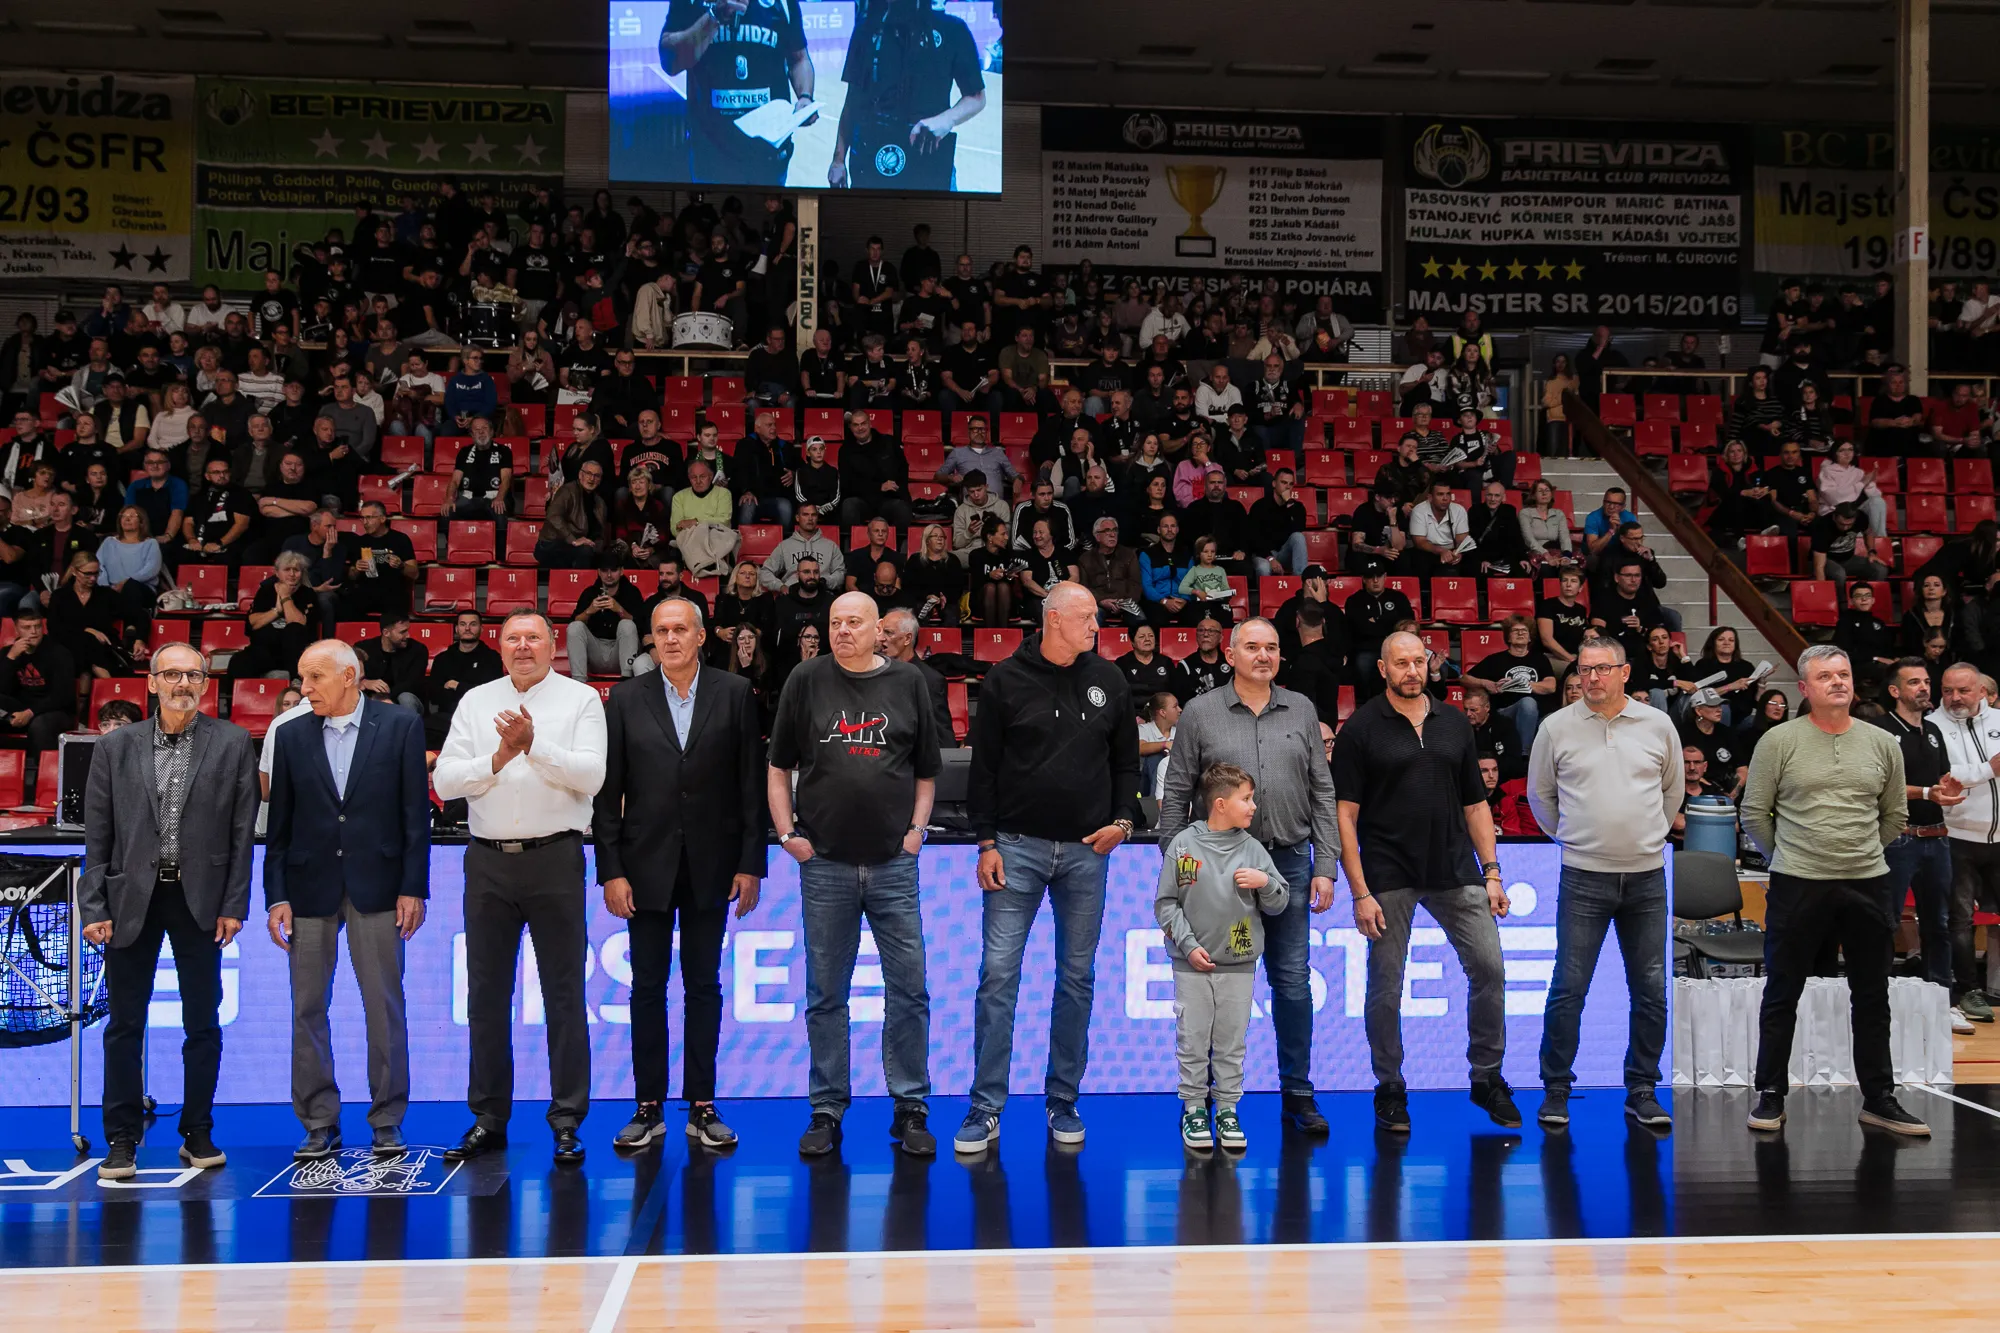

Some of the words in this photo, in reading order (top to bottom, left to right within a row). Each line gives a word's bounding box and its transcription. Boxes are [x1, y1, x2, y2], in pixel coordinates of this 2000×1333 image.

[0, 75, 173, 121] evidza
[716, 93, 769, 103] PARTNERS
[269, 93, 326, 116] BC
[332, 95, 554, 125] PRIEVIDZA
[1174, 123, 1302, 139] PRIEVIDZA
[27, 121, 168, 172] ČSFR
[1781, 130, 1848, 167] BC
[1503, 140, 1727, 168] PRIEVIDZA
[1067, 161, 1102, 171] Maxim
[1249, 167, 1268, 176] #17
[1270, 167, 1293, 178] Filip
[1500, 169, 1600, 183] BASKETBALL
[1604, 171, 1644, 183] CLUB
[1648, 172, 1731, 186] PRIEVIDZA
[1052, 175, 1065, 184] #4
[1068, 175, 1099, 184] Jakub
[1102, 175, 1150, 187] Pasovský
[1271, 180, 1301, 190] Jakub
[1052, 187, 1065, 196] #5
[1068, 188, 1097, 198] Matej
[1248, 193, 1267, 201] #21
[1307, 194, 1350, 203] Johnson
[1410, 192, 1491, 208] PASOVSKÝ
[1500, 195, 1607, 208] ROSTAMPOUR
[1674, 198, 1729, 210] BATINA
[1053, 200, 1072, 209] #10
[1075, 200, 1108, 210] Nenad
[1248, 206, 1267, 215] #23
[1270, 206, 1309, 216] Ibrahim
[1312, 207, 1345, 216] Durmo
[1053, 213, 1072, 222] #12
[1075, 214, 1114, 223] Andrew
[1117, 214, 1157, 226] Guillory
[1249, 219, 1268, 228] #25
[1271, 219, 1301, 229] Jakub
[1052, 227, 1072, 236] #15
[1075, 227, 1107, 236] Nikola
[1249, 232, 1268, 241] #55
[1271, 232, 1302, 241] Zlatko
[1410, 226, 1472, 240] HULJAK
[1481, 228, 1535, 241] HUPKA
[1612, 227, 1669, 242] KÁDAŠI
[1678, 231, 1738, 243] VOJTEK
[1052, 239, 1072, 248] #16
[1074, 240, 1103, 249] Adam
[1106, 240, 1140, 250] Antoni
[1913, 231, 1924, 255] F
[1224, 246, 1273, 256] Krunoslav
[1655, 252, 1672, 264] M.
[3, 262, 44, 273] Jusko
[1224, 258, 1254, 267] Maroš
[1257, 258, 1299, 269] Helmecy
[1307, 260, 1347, 269] asistent
[1285, 276, 1373, 297] POHÁRA
[1408, 289, 1544, 314] MAJSTER
[1551, 292, 1590, 314] SR
[1598, 292, 1739, 316] 2015/2016
[1348, 421, 1357, 429] 27
[1272, 454, 1281, 462] 25
[1370, 455, 1378, 463] 27
[1239, 491, 1248, 499] 24
[529, 525, 536, 533] 11
[1311, 535, 1320, 543] 25
[508, 574, 516, 582] 11
[569, 574, 578, 582] 12
[629, 574, 638, 583] 13
[1278, 580, 1288, 589] 24
[1333, 580, 1344, 589] 25
[1448, 581, 1458, 590] 27
[421, 629, 430, 638] 10
[489, 630, 497, 638] 11
[933, 632, 942, 642] 18
[1120, 633, 1128, 642] 21
[1177, 633, 1188, 642] 22
[1480, 635, 1490, 644] 27
[1452, 691, 1463, 701] 26
[819, 710, 889, 745] AIR
